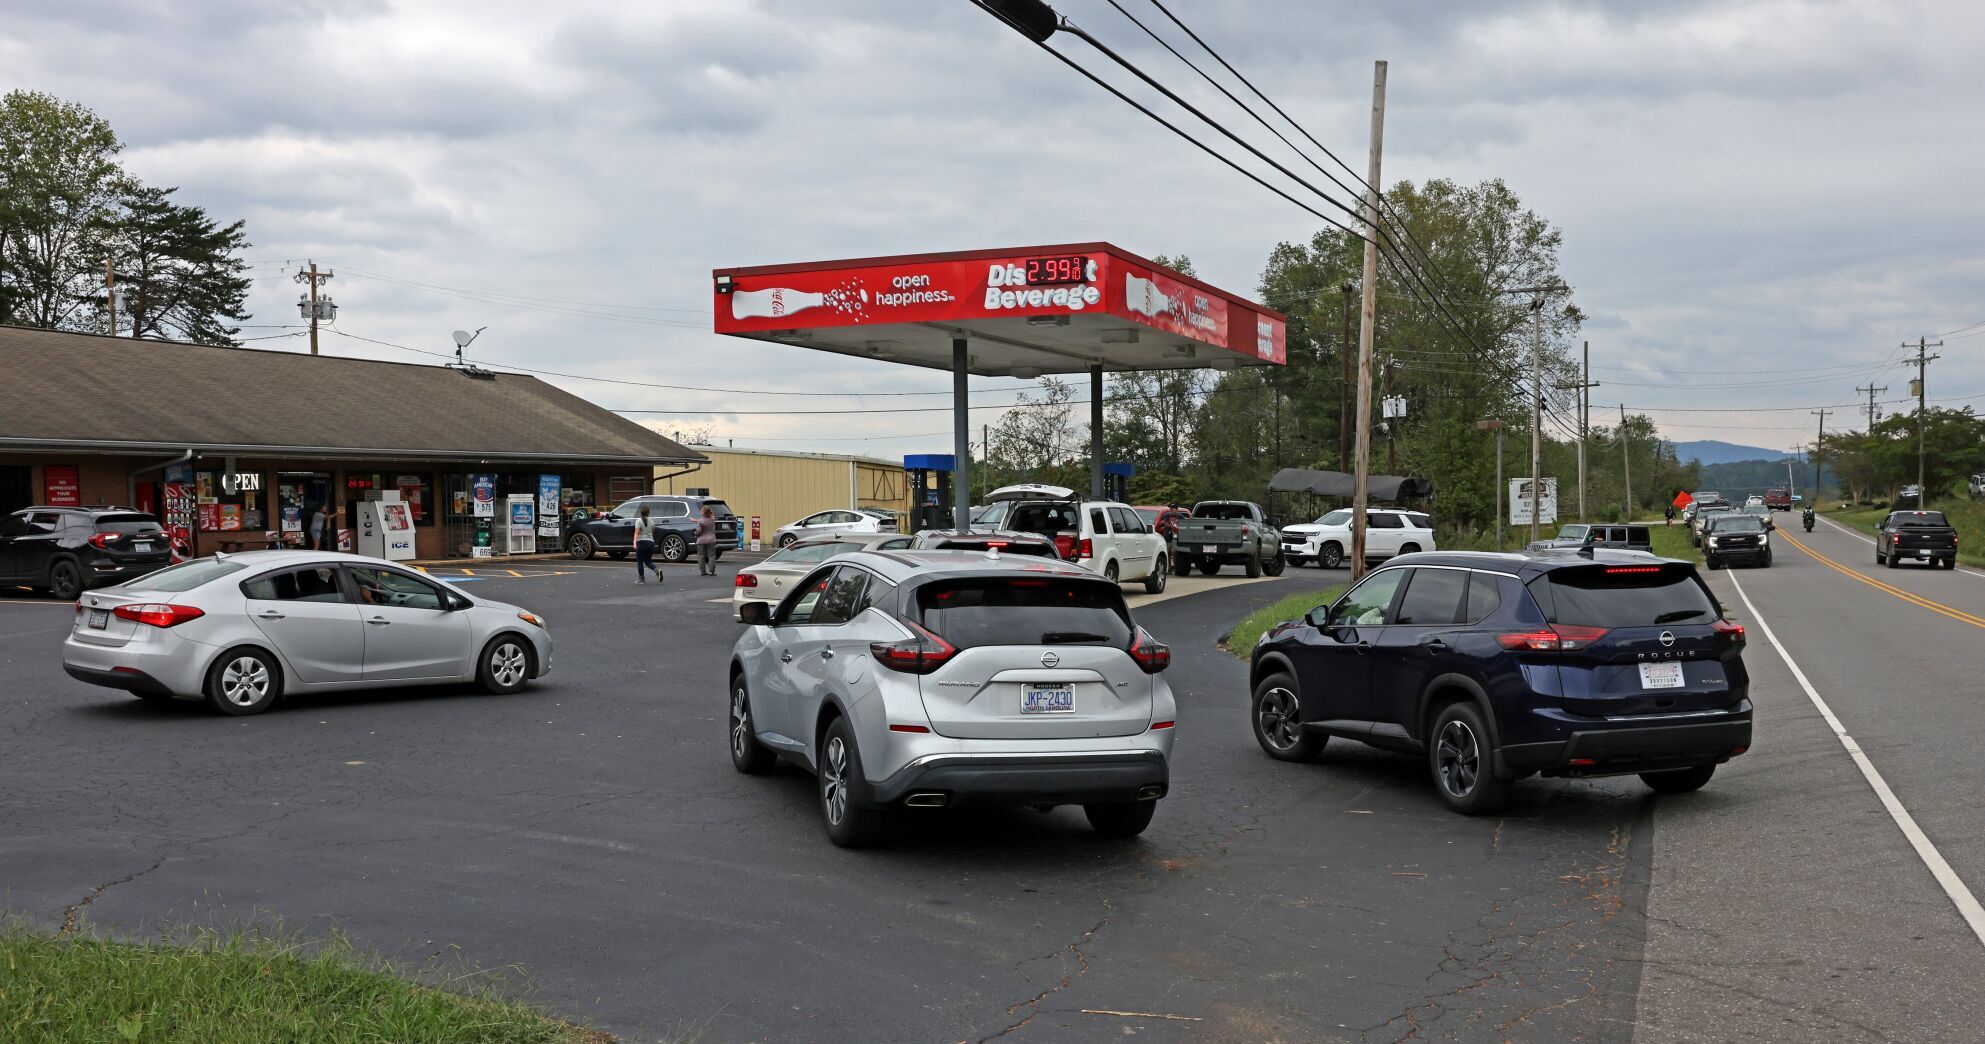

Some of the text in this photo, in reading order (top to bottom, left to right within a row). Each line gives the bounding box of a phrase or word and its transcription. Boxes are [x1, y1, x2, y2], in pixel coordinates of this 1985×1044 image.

[892, 274, 930, 288] open
[984, 283, 1100, 310] Beverage
[1637, 650, 1696, 660] ROGUE
[1024, 691, 1073, 706] JKP-2430
